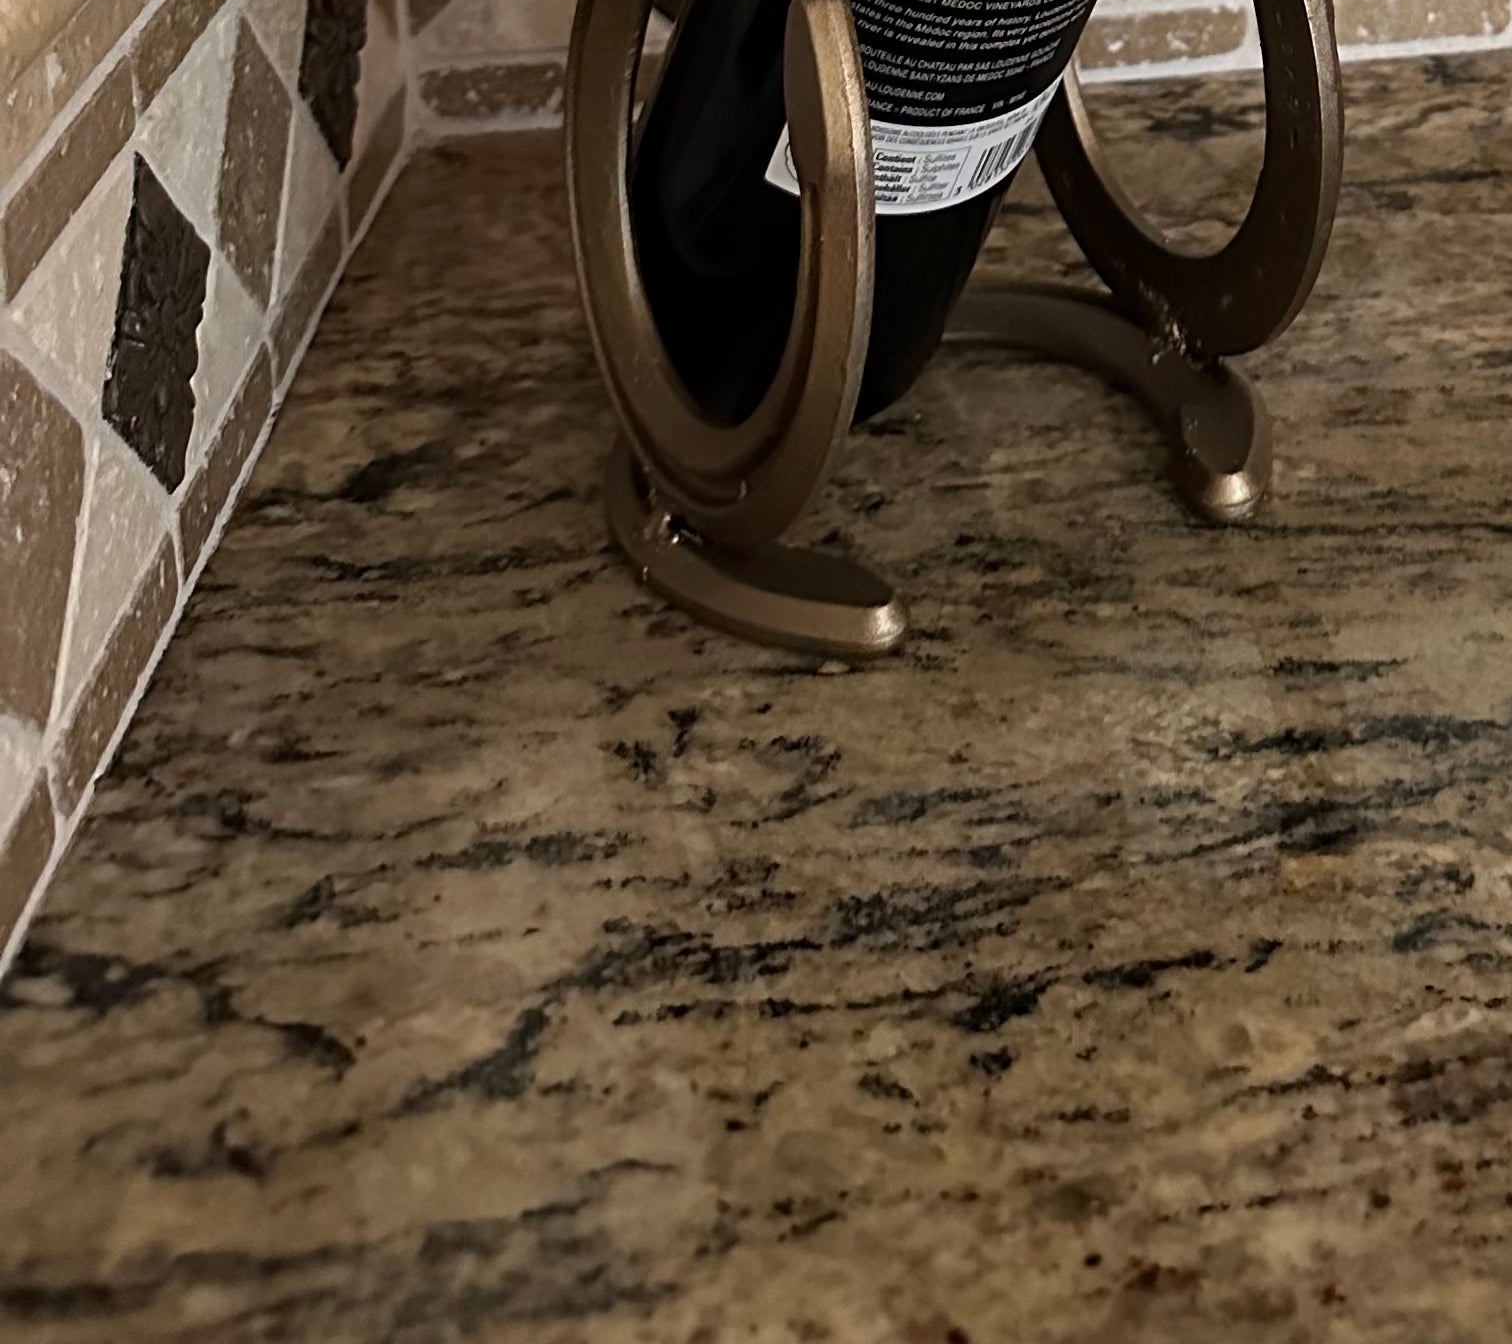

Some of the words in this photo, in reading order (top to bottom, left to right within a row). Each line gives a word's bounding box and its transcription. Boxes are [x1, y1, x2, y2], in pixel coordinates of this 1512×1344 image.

[850, 1, 882, 21] states
[882, 14, 895, 25] in
[895, 18, 914, 31] the
[903, 7, 952, 25] hundred
[951, 17, 983, 28] years
[984, 17, 998, 27] of
[857, 18, 883, 34] river
[883, 28, 895, 38] is
[895, 32, 946, 49] revealed
[945, 41, 957, 51] in
[958, 41, 979, 52] this
[903, 56, 918, 68] AU
[973, 60, 992, 72] SAS
[864, 78, 946, 102] AU-LOUDENNE.COM
[899, 104, 942, 118] PRODUCT
